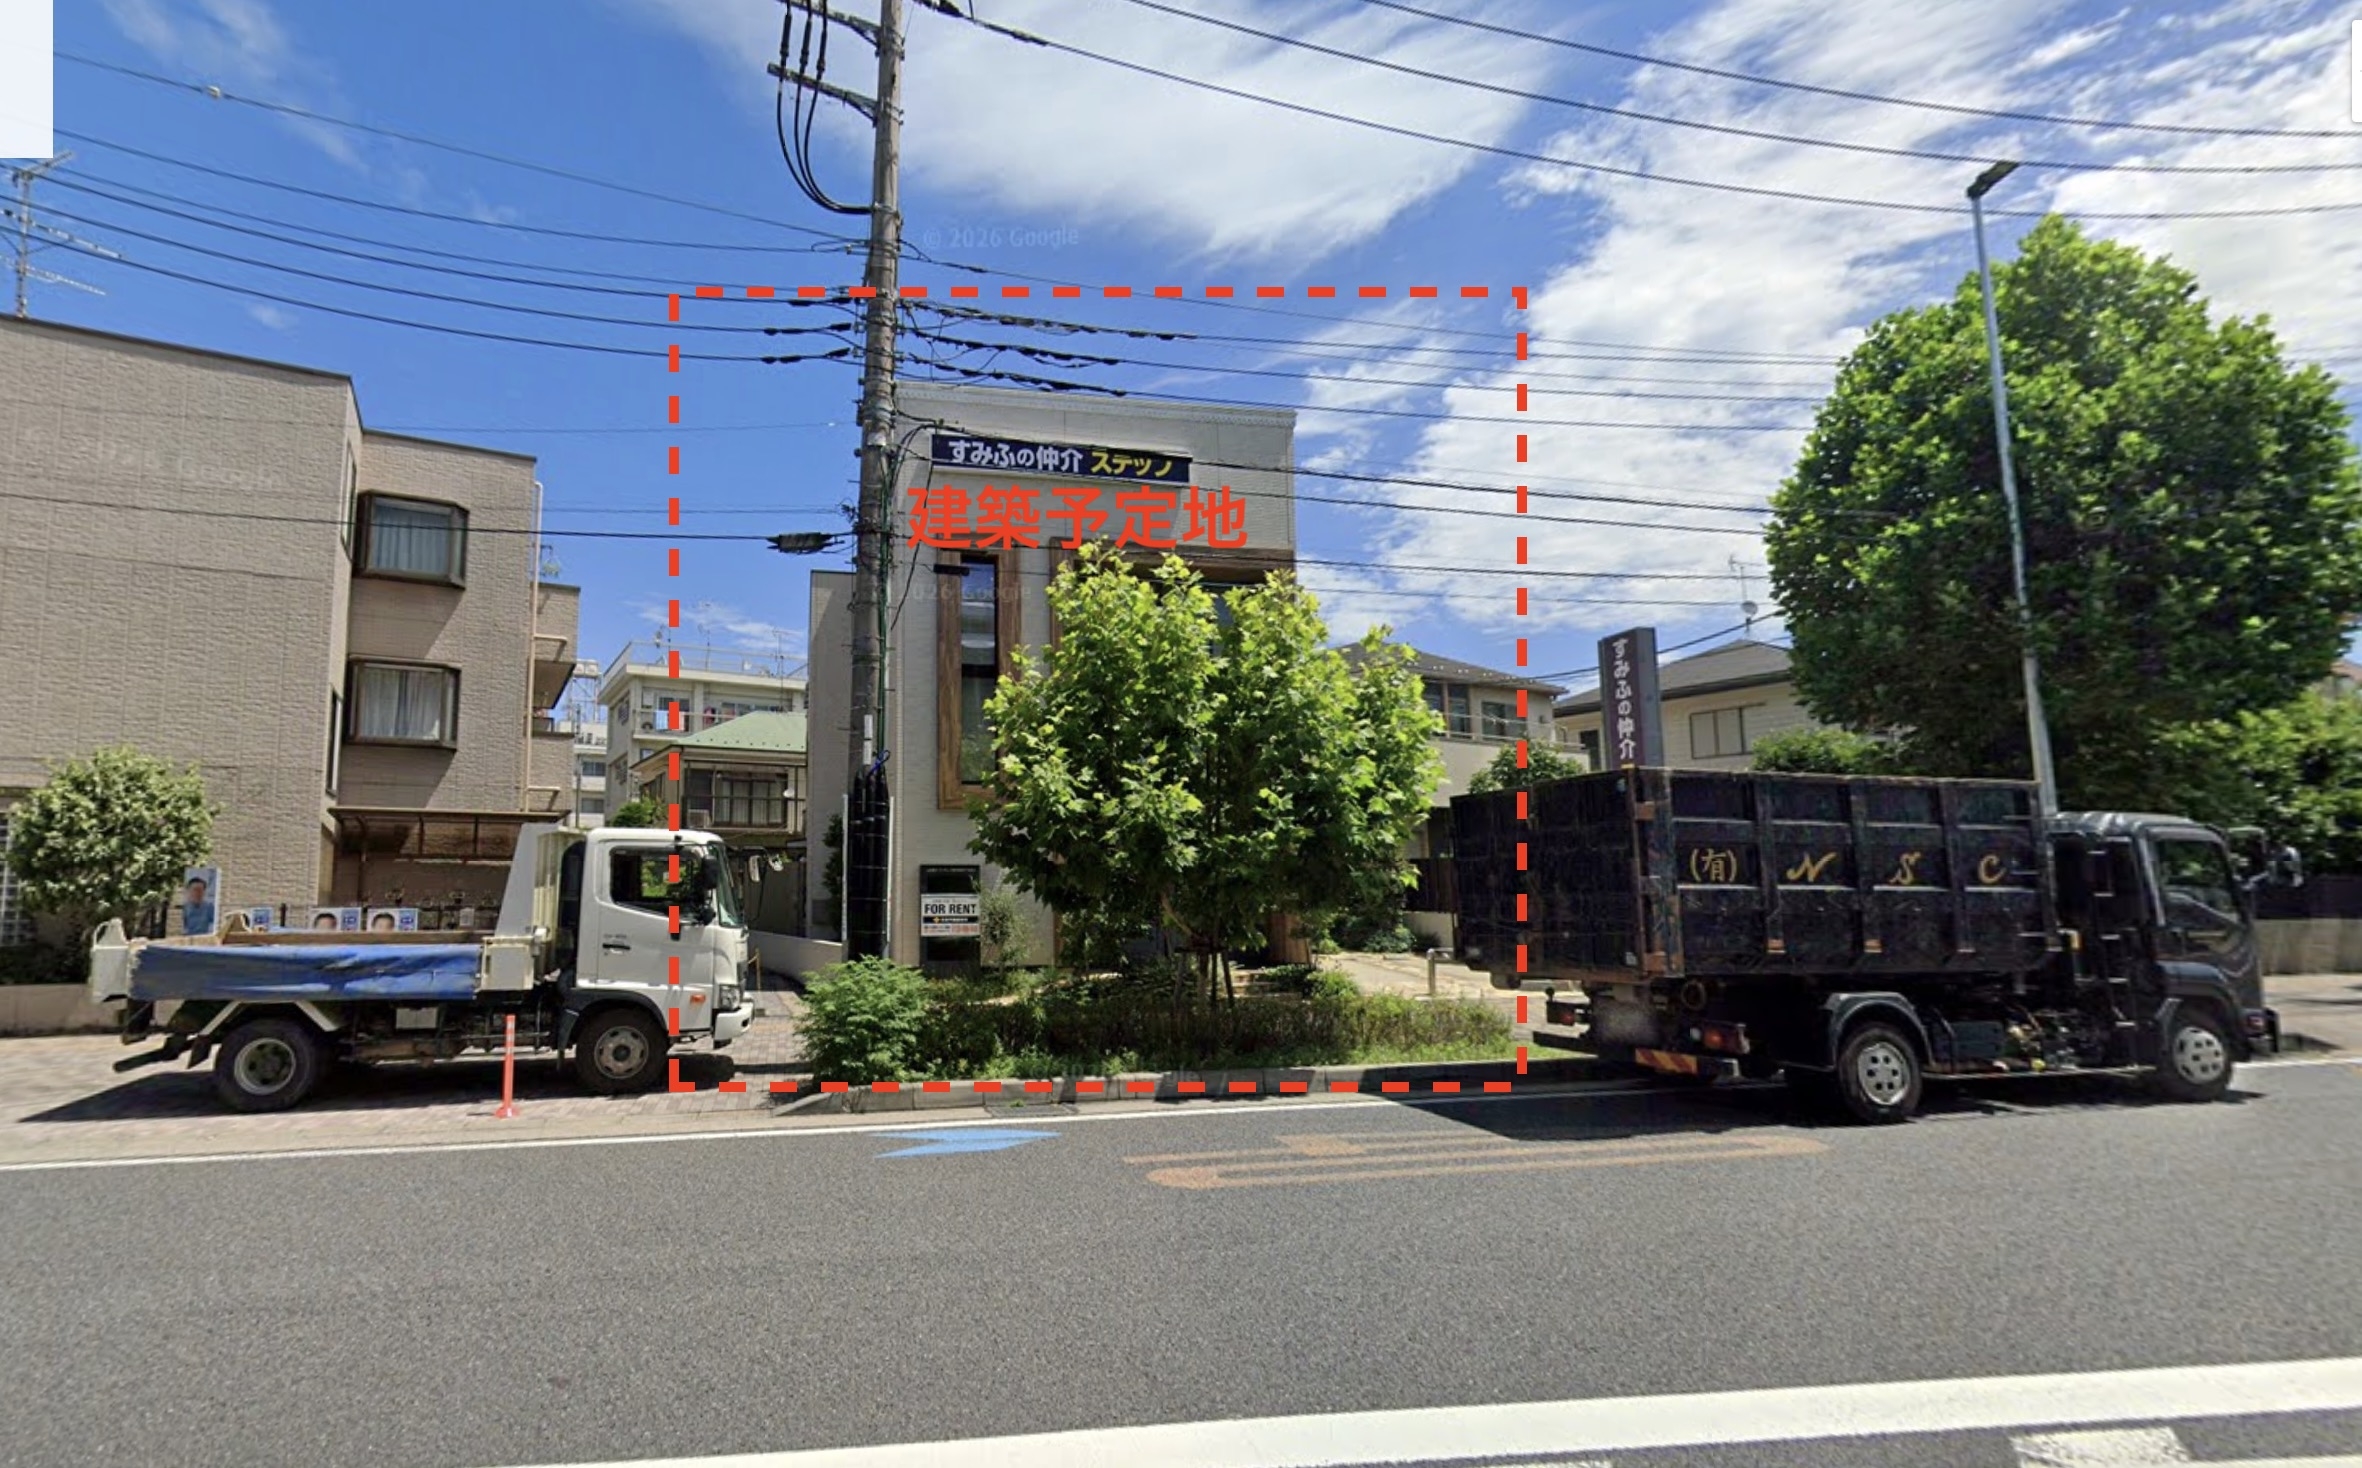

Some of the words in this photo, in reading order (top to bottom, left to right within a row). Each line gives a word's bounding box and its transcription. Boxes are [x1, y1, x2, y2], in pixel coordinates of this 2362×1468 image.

[949, 439, 1083, 473] すみふの仲介
[1612, 638, 1637, 760] すみふの仲介
[1689, 847, 1738, 883] (有)
[924, 903, 946, 915] FOR
[949, 903, 977, 915] RENT
